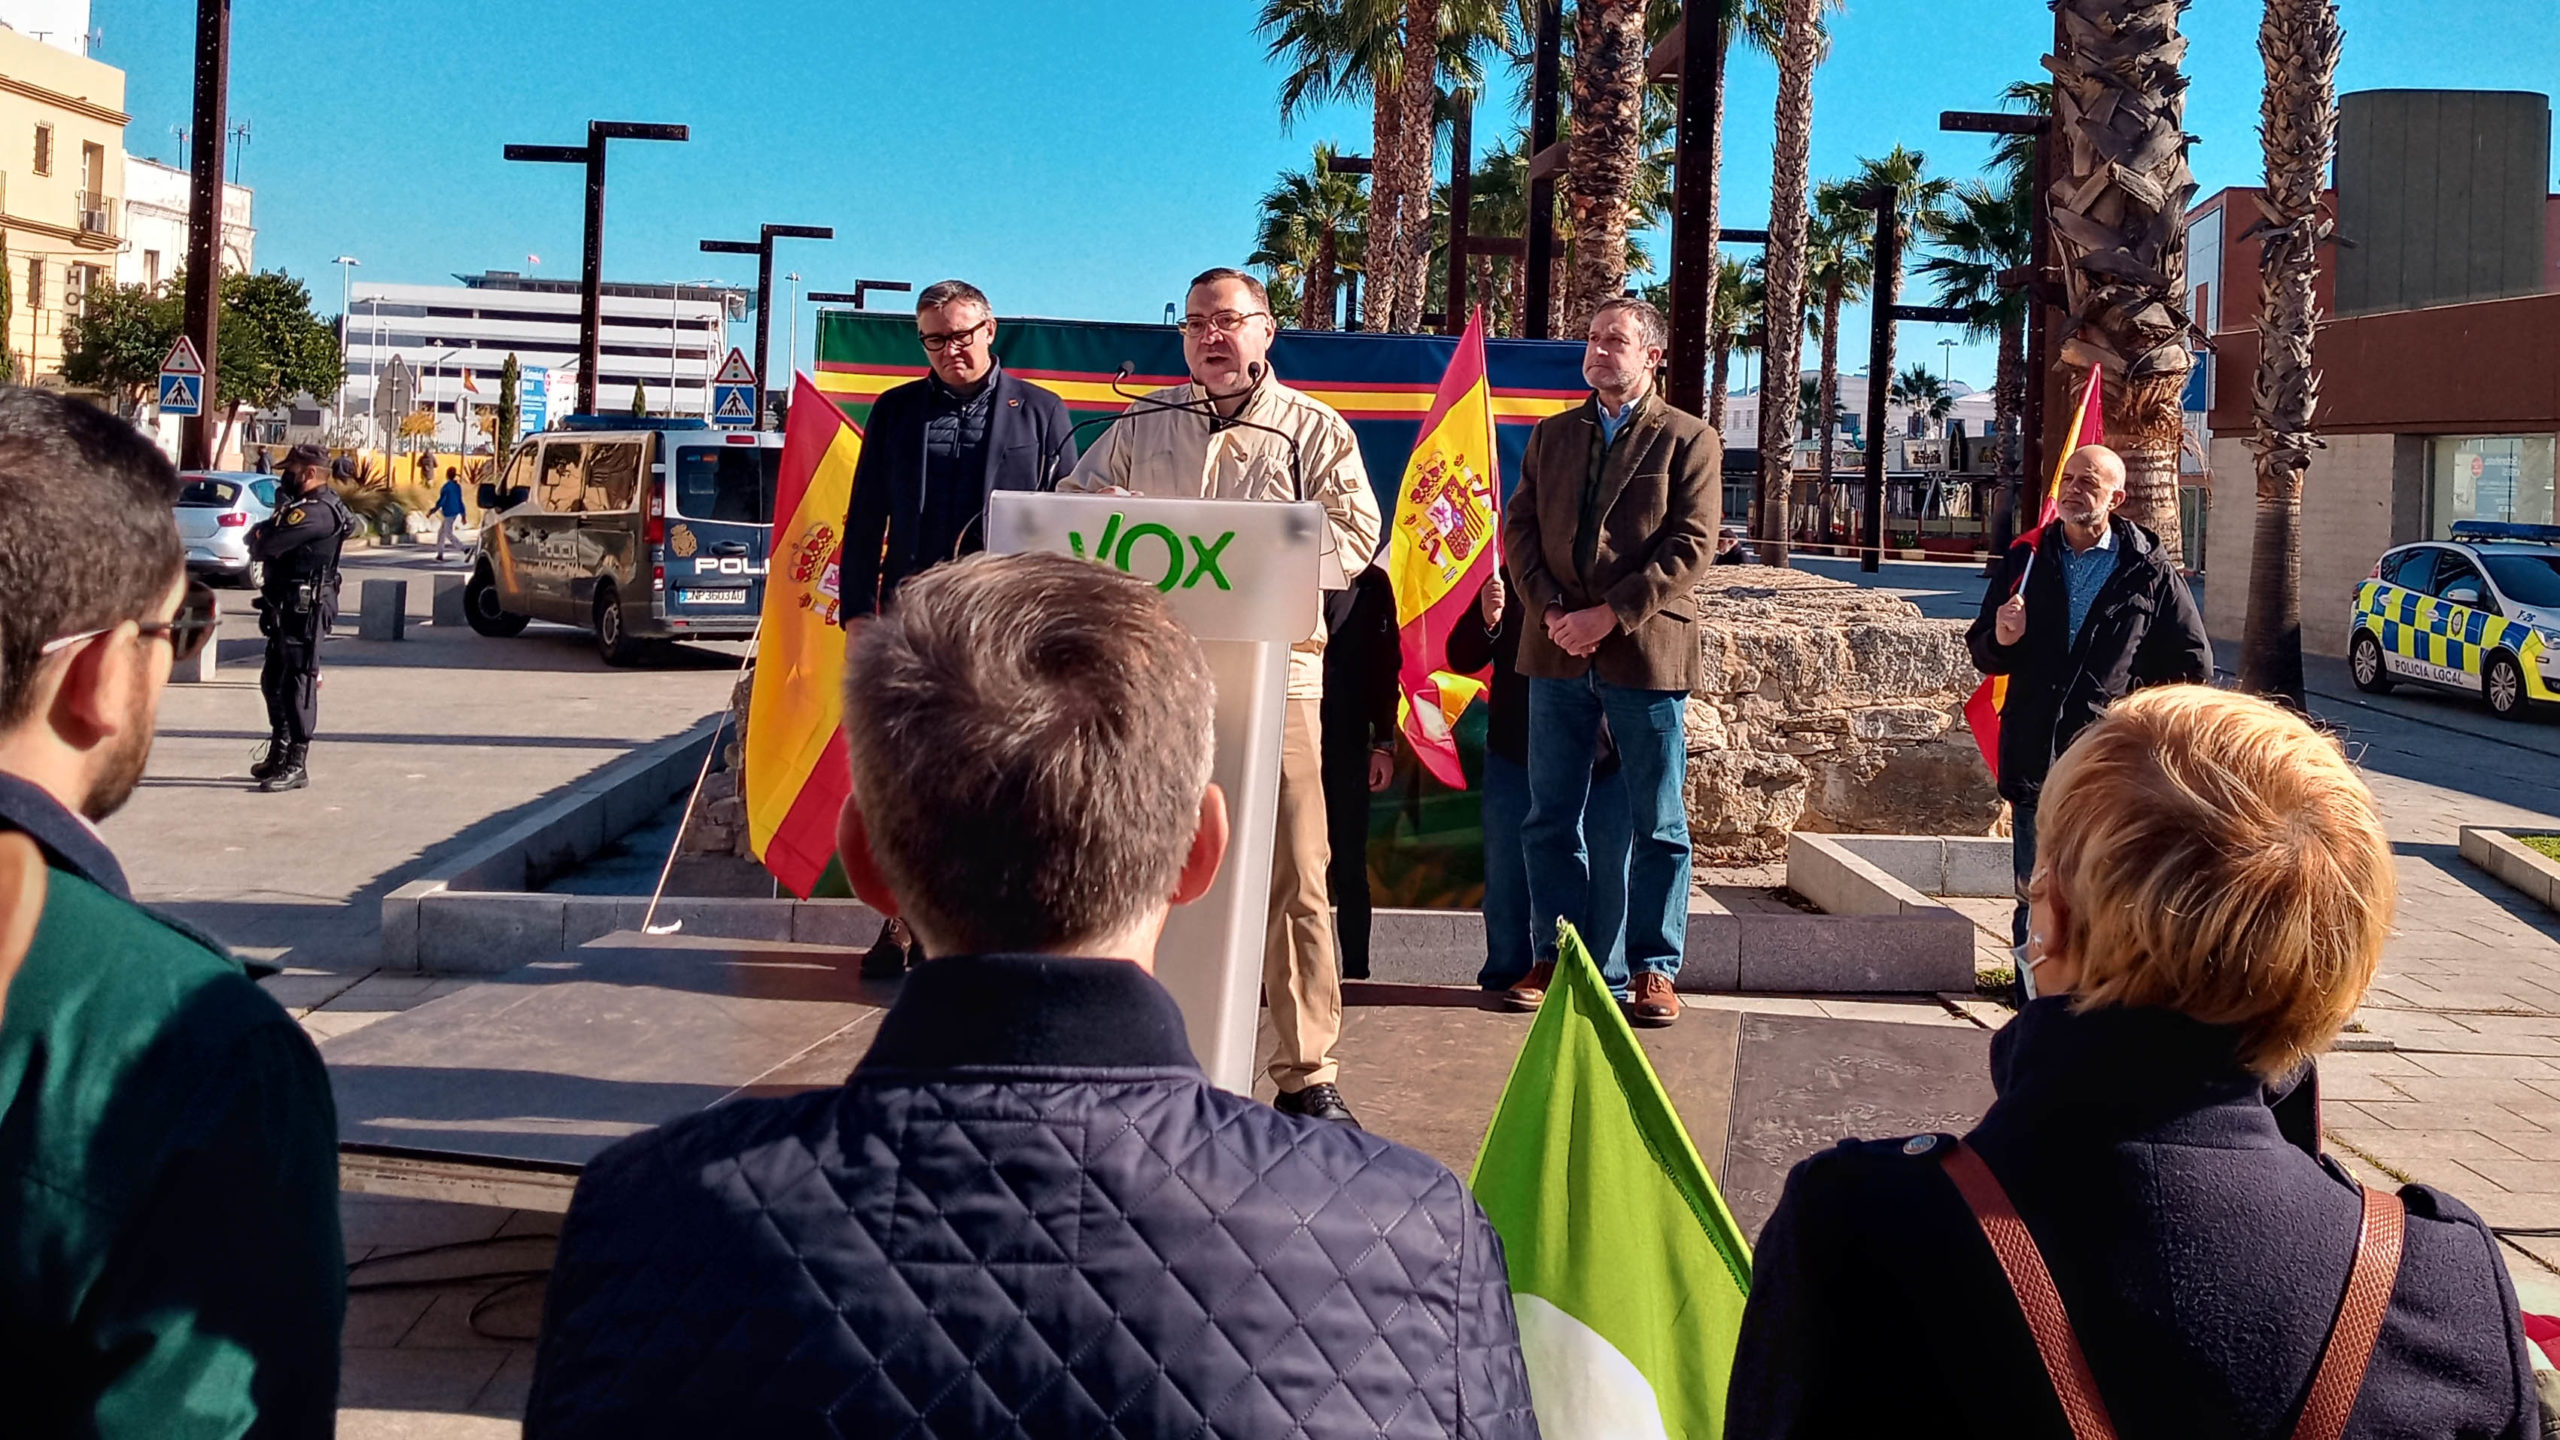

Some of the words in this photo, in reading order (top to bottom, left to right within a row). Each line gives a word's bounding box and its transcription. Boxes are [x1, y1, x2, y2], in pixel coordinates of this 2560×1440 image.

[694, 557, 771, 575] POLI
[1068, 512, 1236, 594] VOX
[2394, 659, 2430, 678] POLICIA
[2433, 667, 2464, 685] LOCAL
